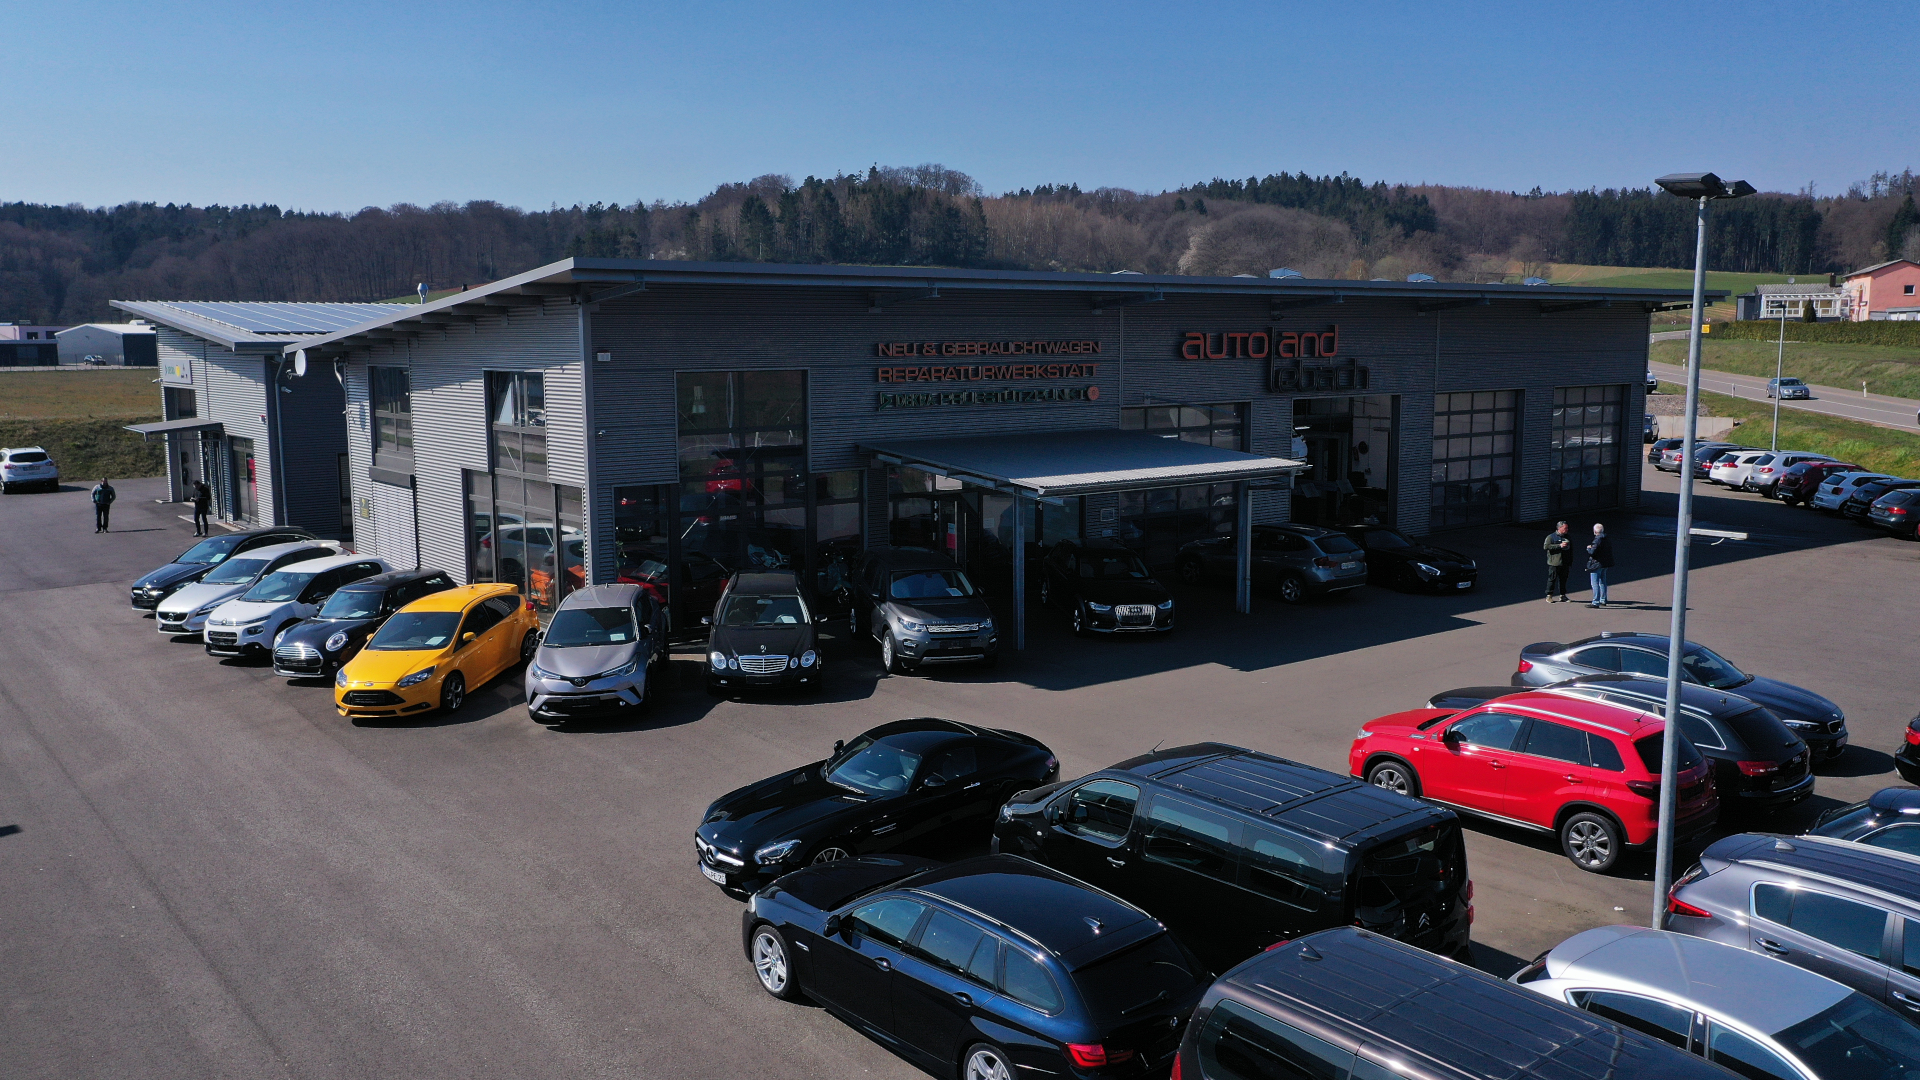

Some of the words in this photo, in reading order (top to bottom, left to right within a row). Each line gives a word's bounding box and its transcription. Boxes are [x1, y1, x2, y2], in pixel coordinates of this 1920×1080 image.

[878, 342, 917, 357] NEU
[922, 342, 937, 356] &
[941, 341, 1102, 356] GEBRAUCHTWAGEN
[878, 363, 1101, 382] REPARATURWERKSTATT
[895, 392, 936, 408] DEKRA
